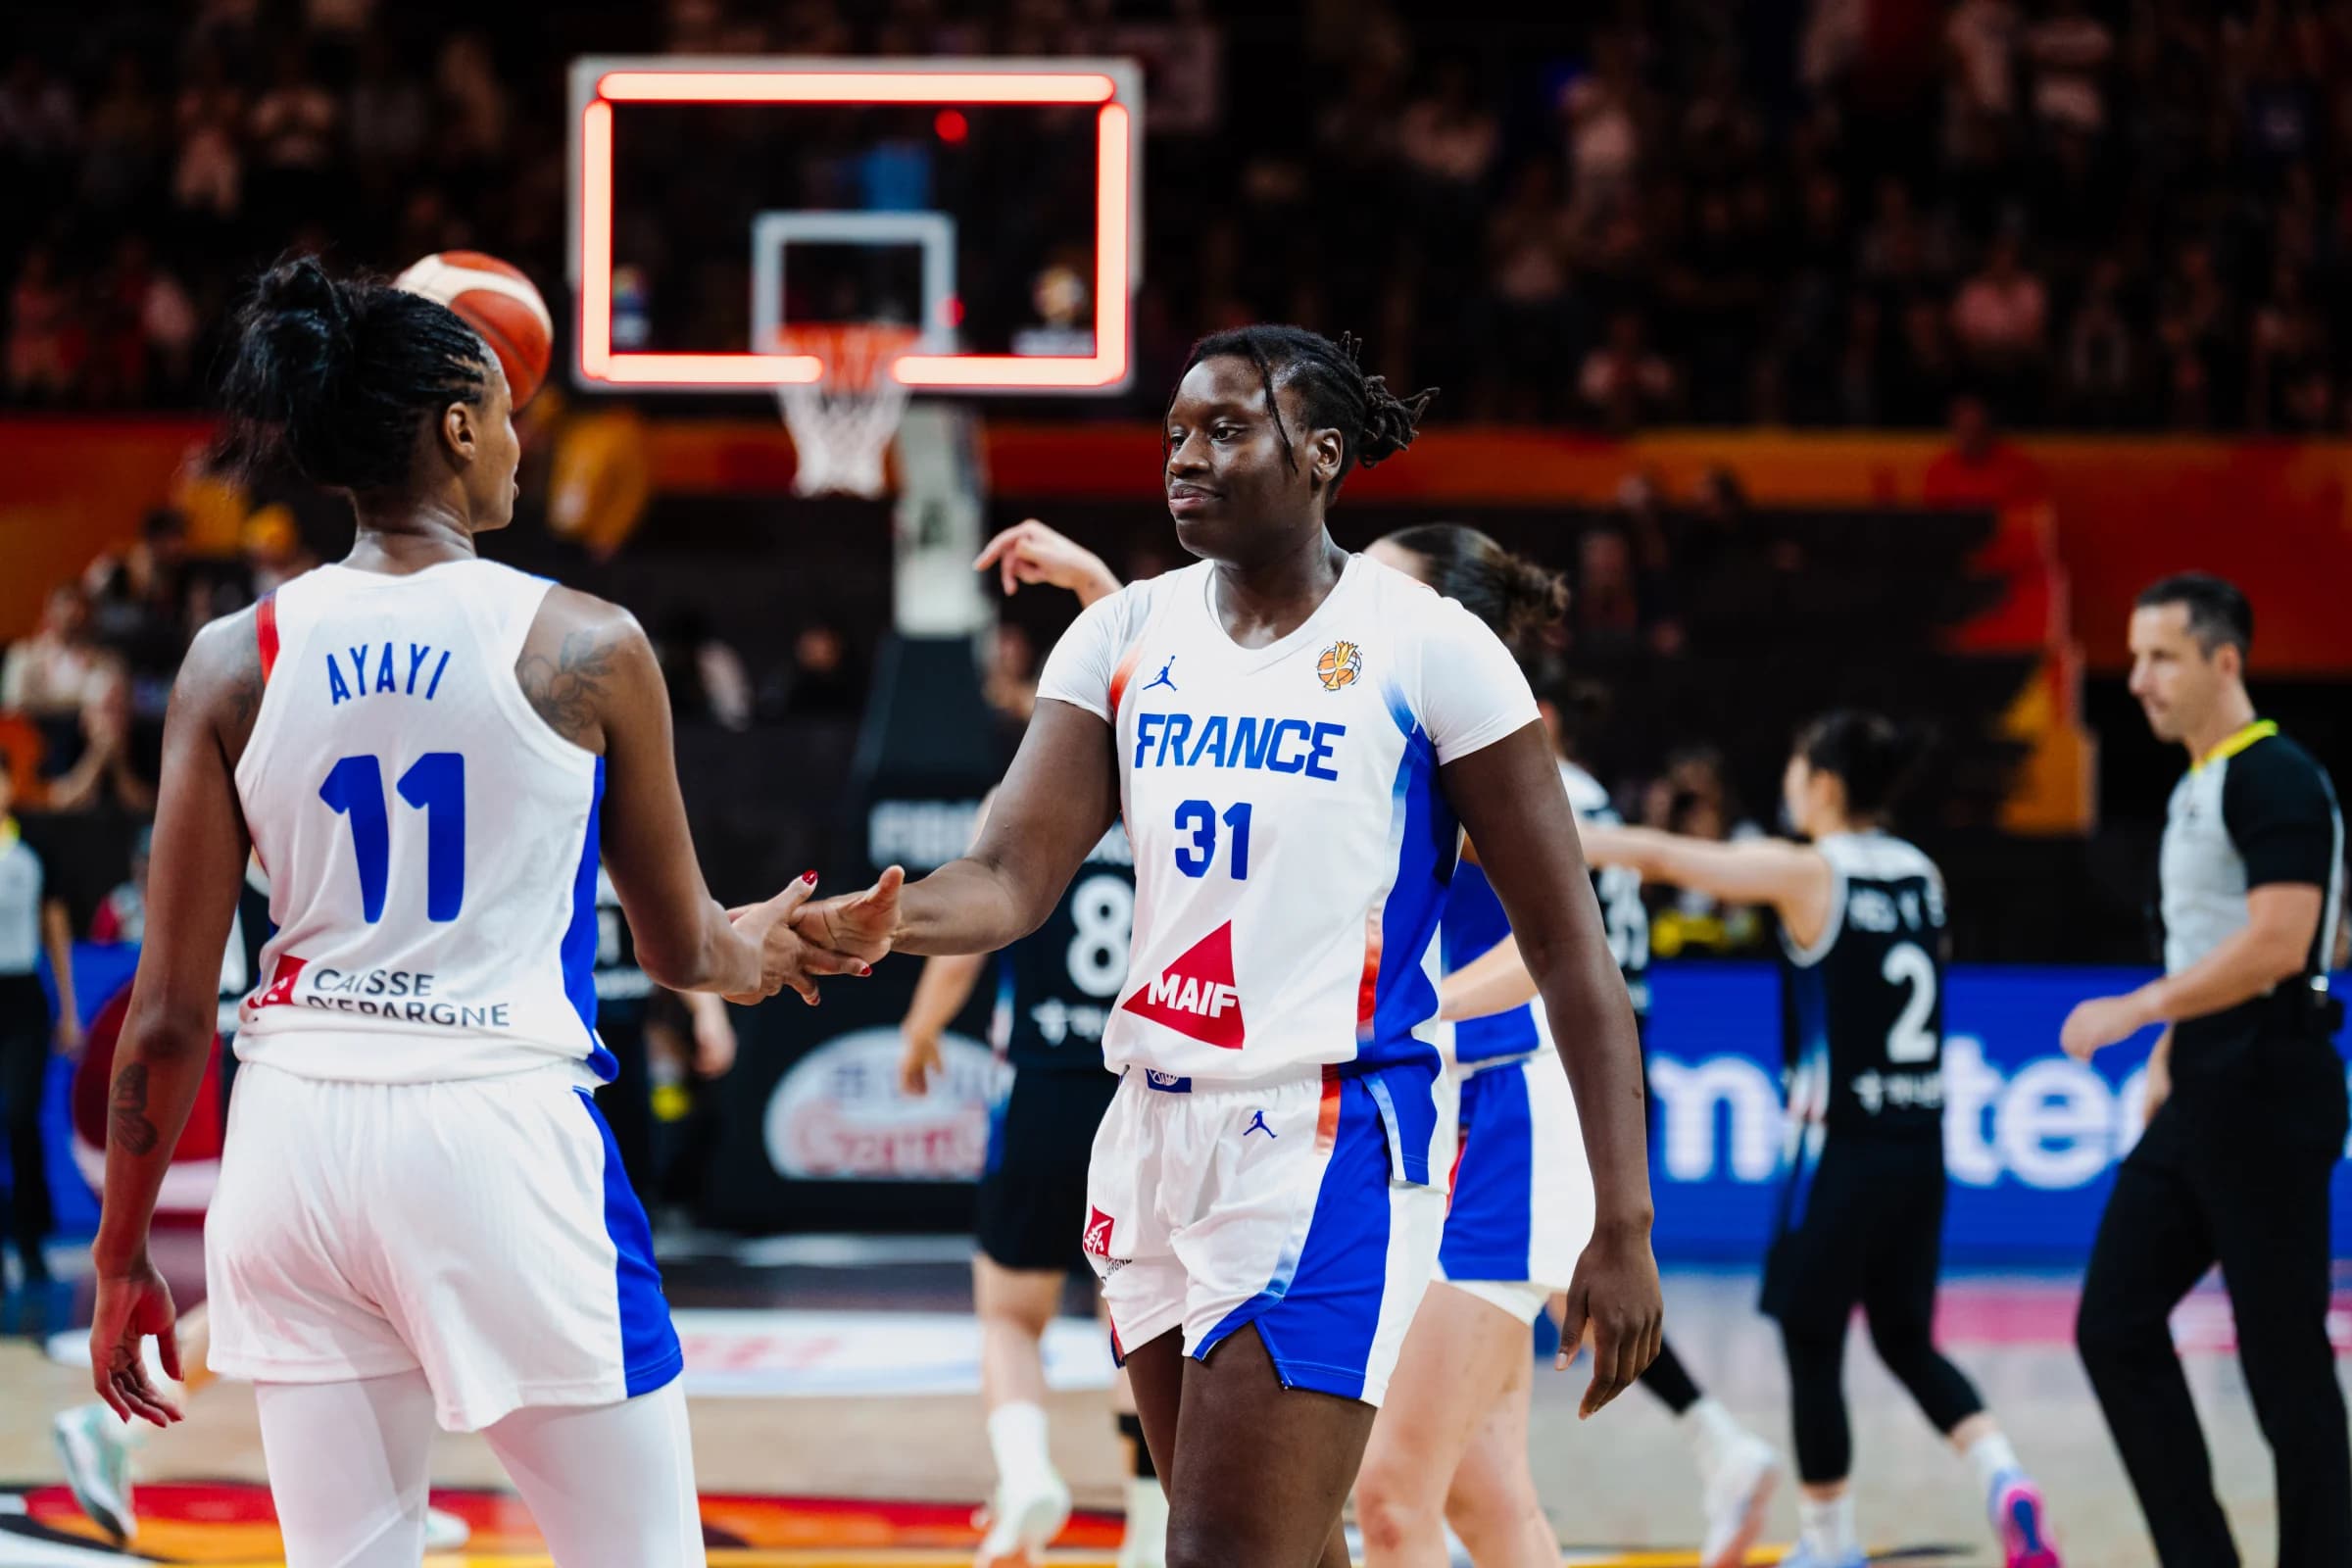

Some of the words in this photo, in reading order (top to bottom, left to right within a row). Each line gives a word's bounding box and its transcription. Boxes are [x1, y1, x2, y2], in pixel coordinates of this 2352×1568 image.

[326, 642, 451, 706] AYAYI
[1135, 713, 1346, 781] FRANCE
[318, 753, 466, 924] 11
[1175, 800, 1252, 880] 31
[1069, 875, 1134, 997] 8
[313, 968, 434, 998] CAISSE
[1147, 972, 1239, 1019] MAIF
[1882, 940, 1938, 1064] 2
